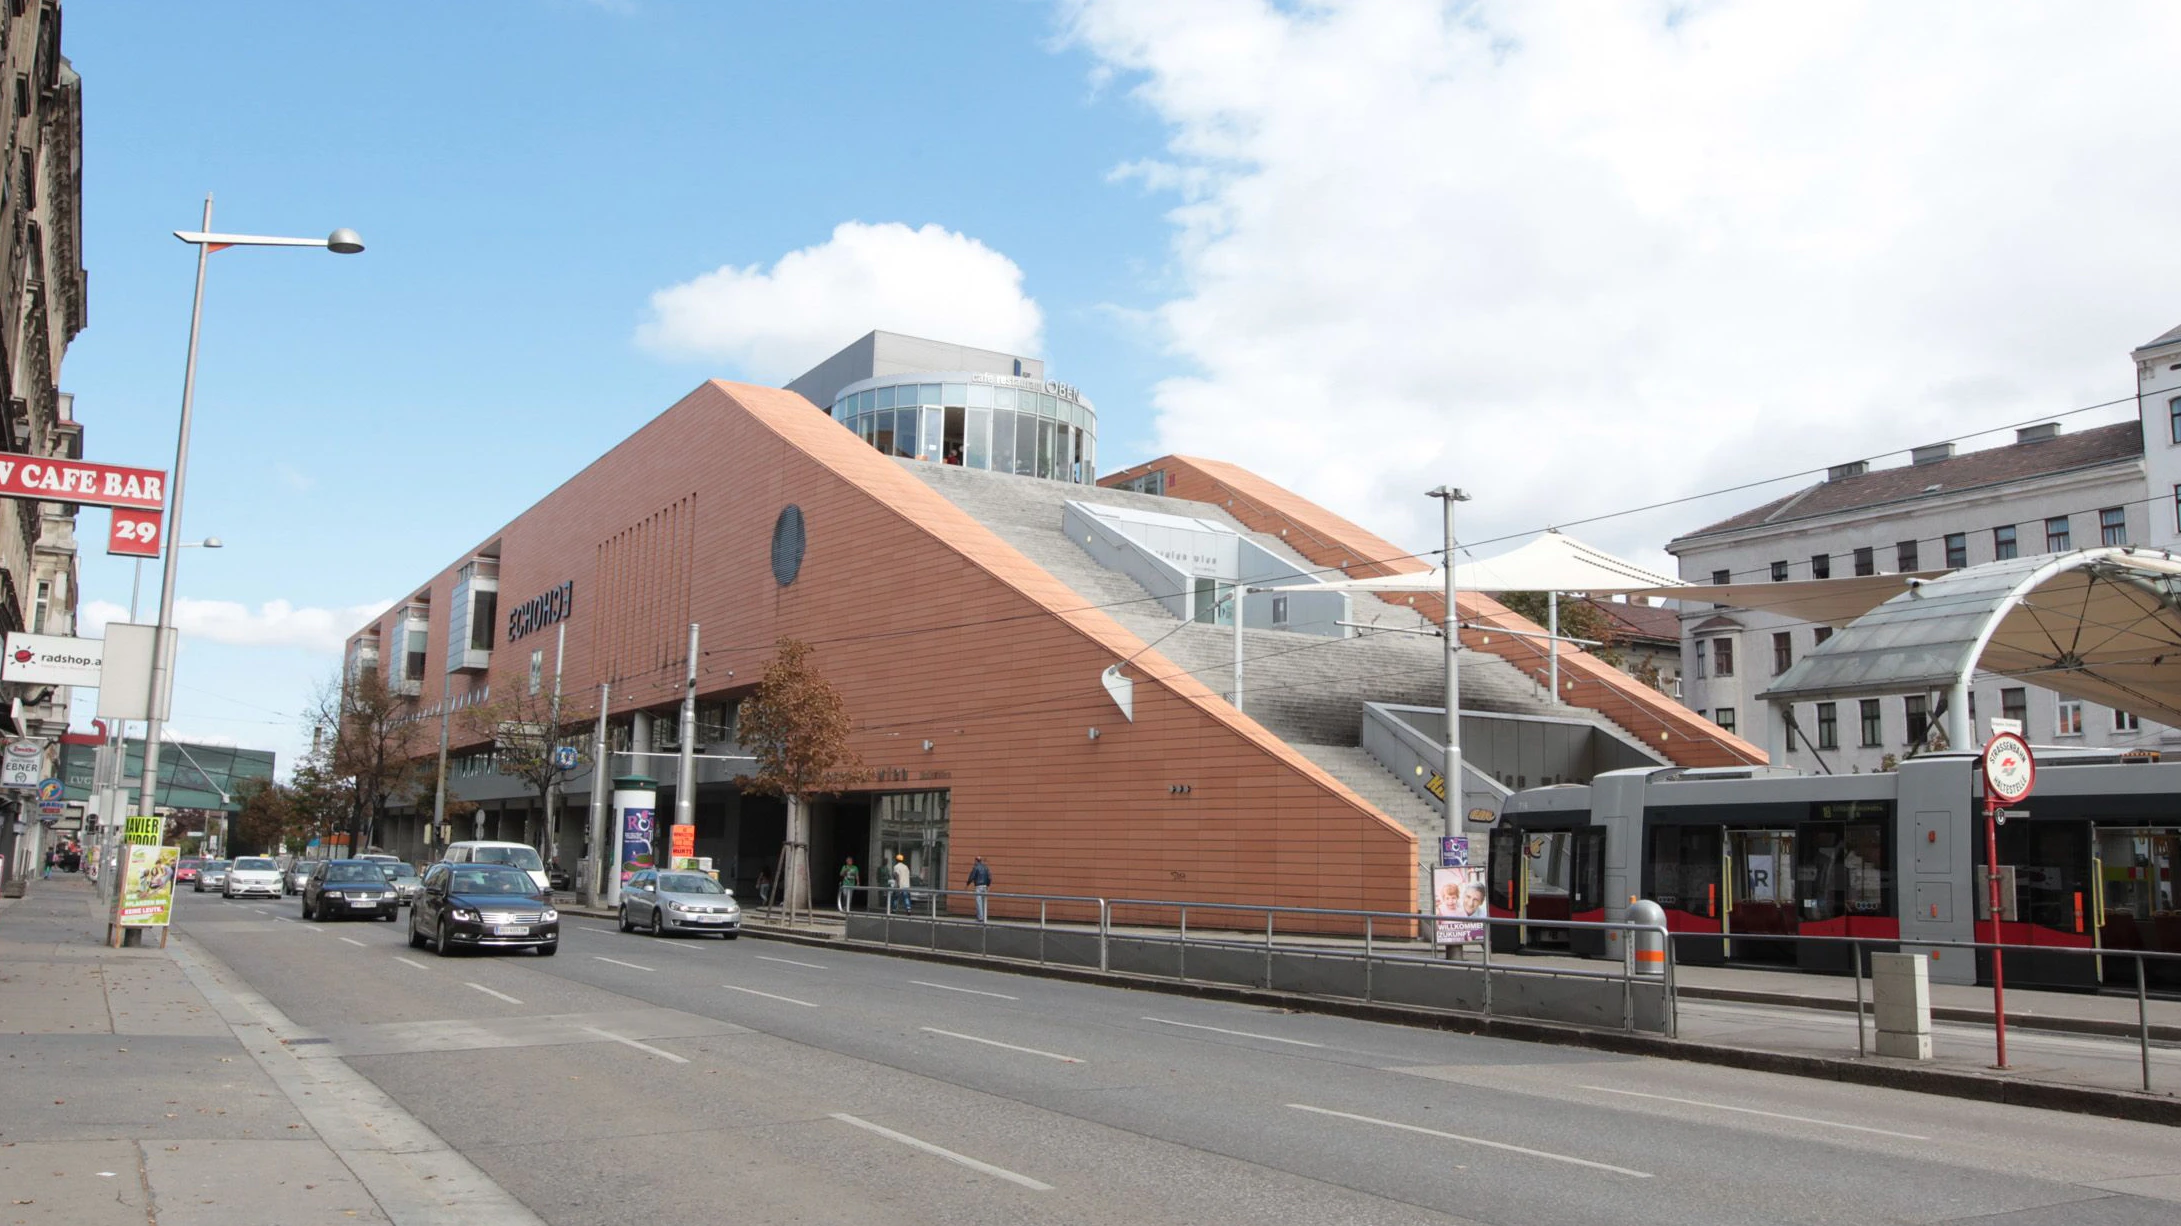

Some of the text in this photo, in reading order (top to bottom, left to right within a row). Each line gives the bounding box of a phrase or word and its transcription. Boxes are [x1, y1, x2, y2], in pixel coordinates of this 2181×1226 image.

[1045, 379, 1081, 403] OBEN
[21, 464, 97, 494] CAFE
[103, 473, 162, 500] BAR
[116, 520, 157, 543] 29
[41, 654, 102, 666] radshop.a
[1989, 742, 2026, 764] STRASSENBAHN
[5, 762, 38, 772] EBNER
[1993, 774, 2027, 795] HALTESTELLE
